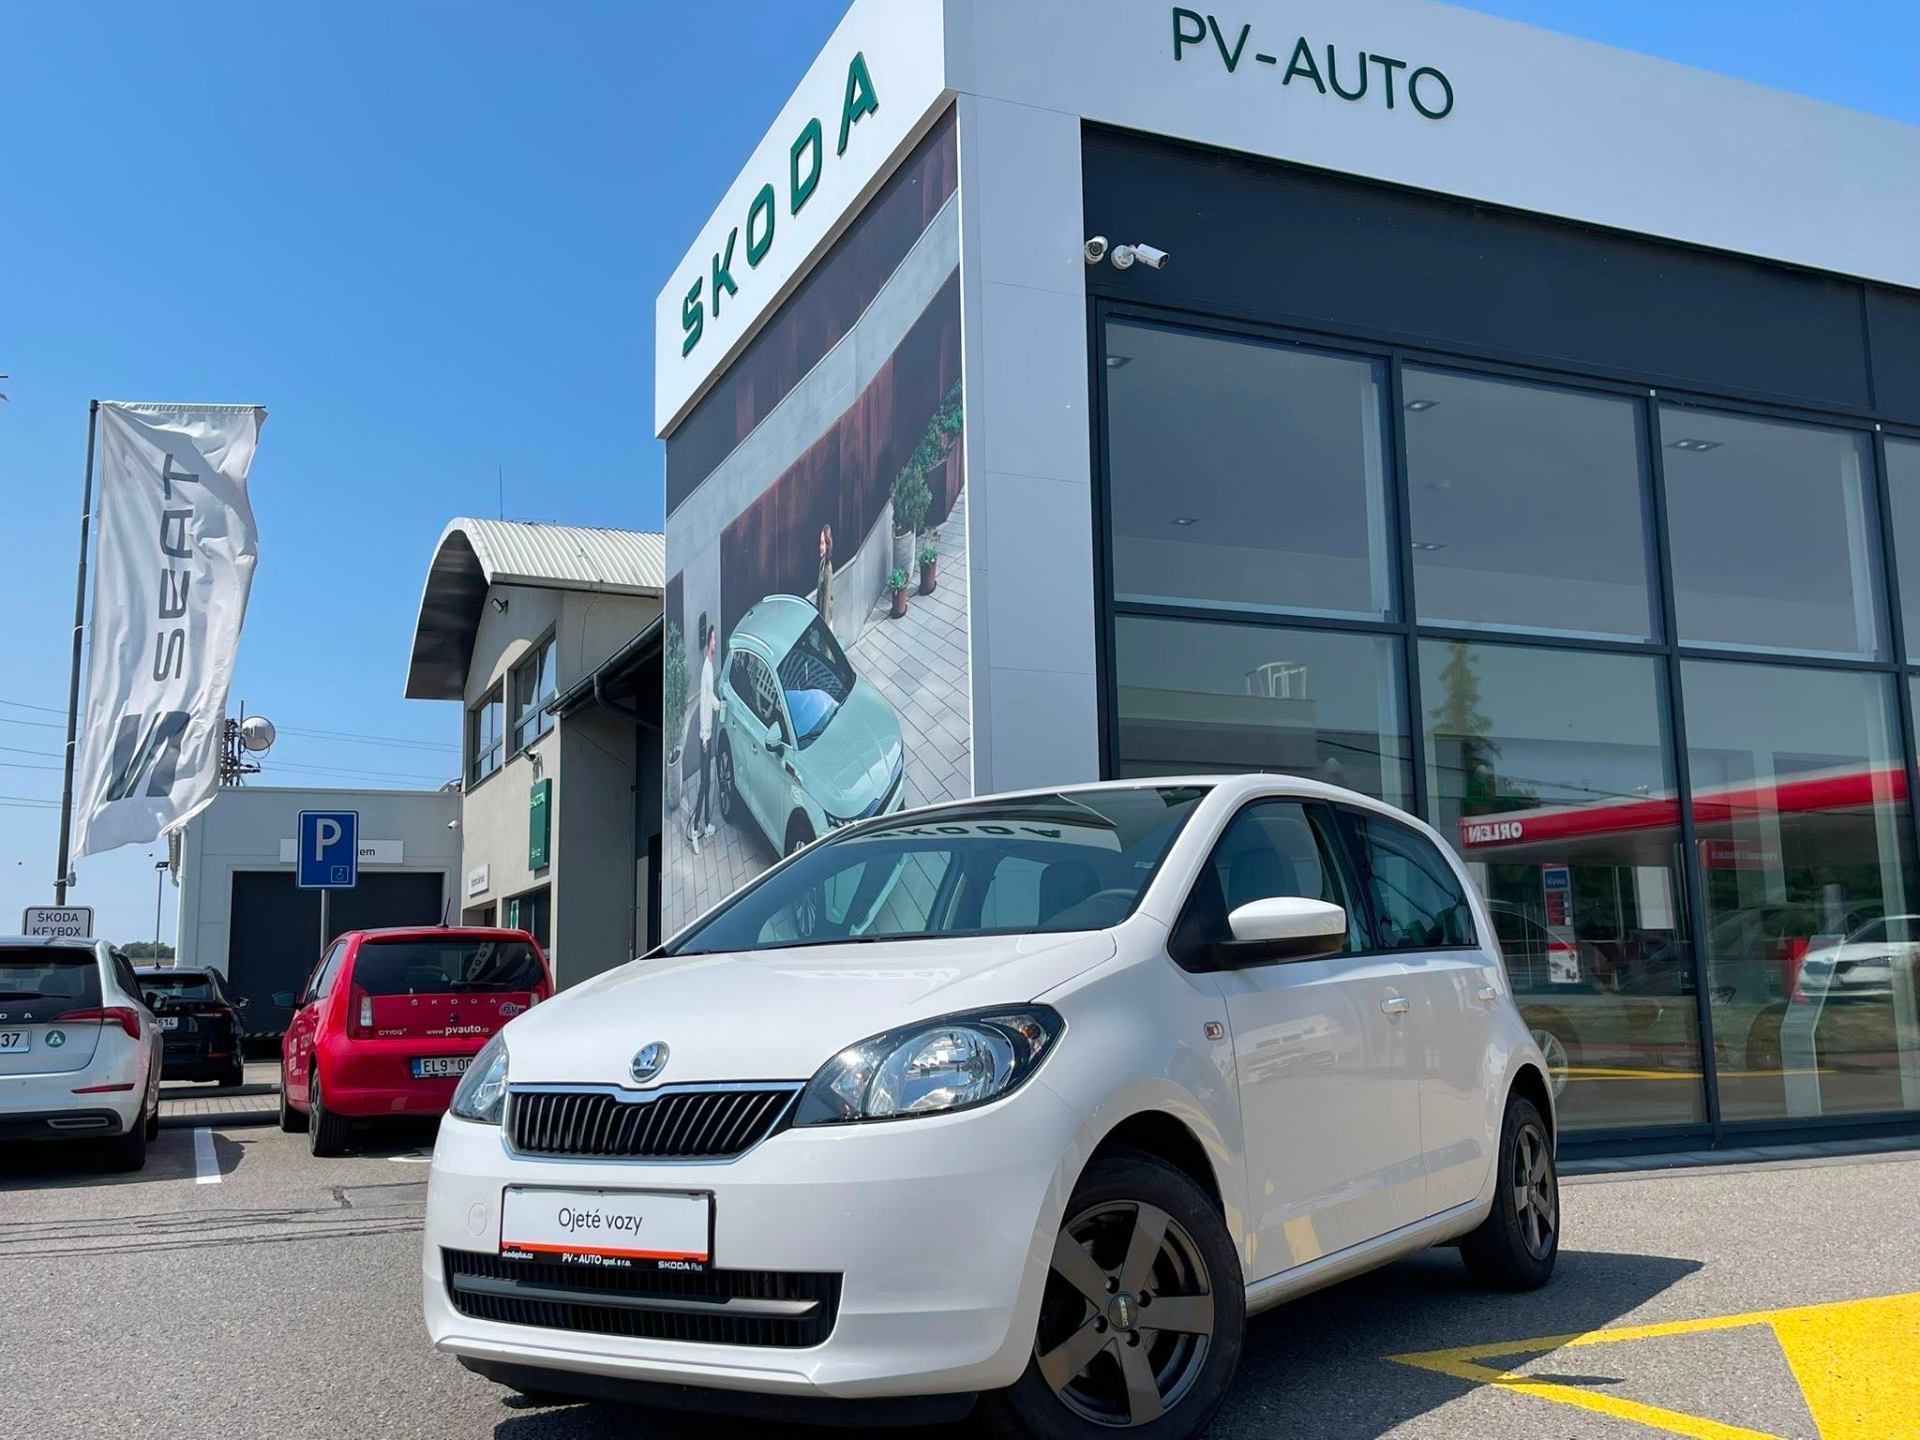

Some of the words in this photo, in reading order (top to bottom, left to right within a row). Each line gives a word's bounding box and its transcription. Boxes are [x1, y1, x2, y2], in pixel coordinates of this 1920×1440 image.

[1172, 6, 1454, 120] PV-AUTO
[152, 452, 200, 683] SEAT
[316, 818, 342, 861] P
[37, 911, 79, 922] ŠKODA
[33, 926, 82, 937] KEYBOX
[1, 1033, 21, 1048] 37
[424, 1059, 448, 1073] EL9
[558, 1207, 600, 1233] Ojeté
[605, 1214, 643, 1236] vozy
[562, 1253, 573, 1263] PV
[579, 1254, 601, 1265] AUTO
